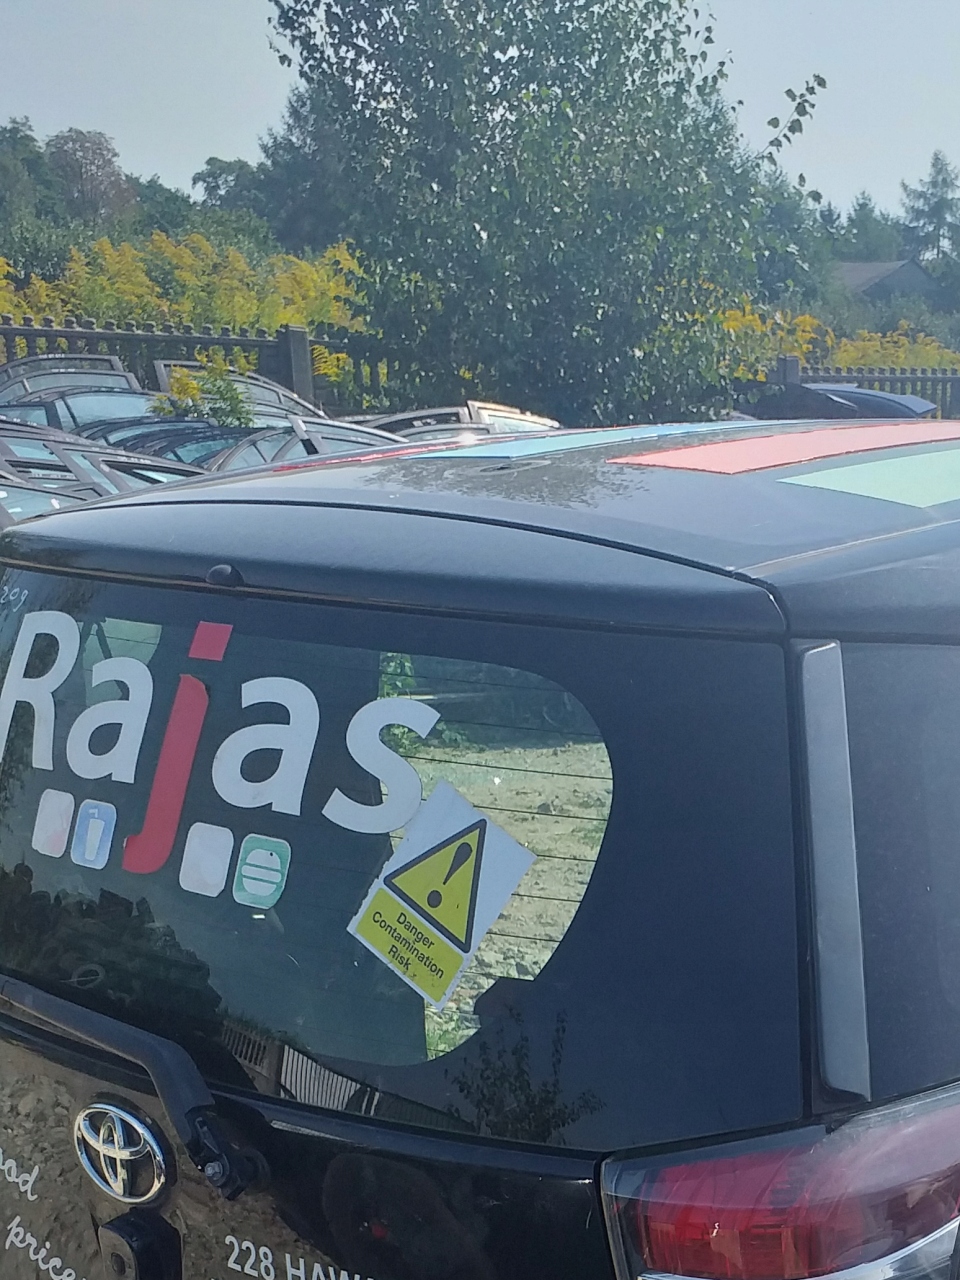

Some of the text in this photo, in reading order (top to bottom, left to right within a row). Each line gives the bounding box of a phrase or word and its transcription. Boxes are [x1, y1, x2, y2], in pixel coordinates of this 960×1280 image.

[0, 610, 441, 874] Rajas
[372, 911, 444, 979] Contamination
[396, 912, 434, 949] Danger
[388, 944, 412, 970] Risk
